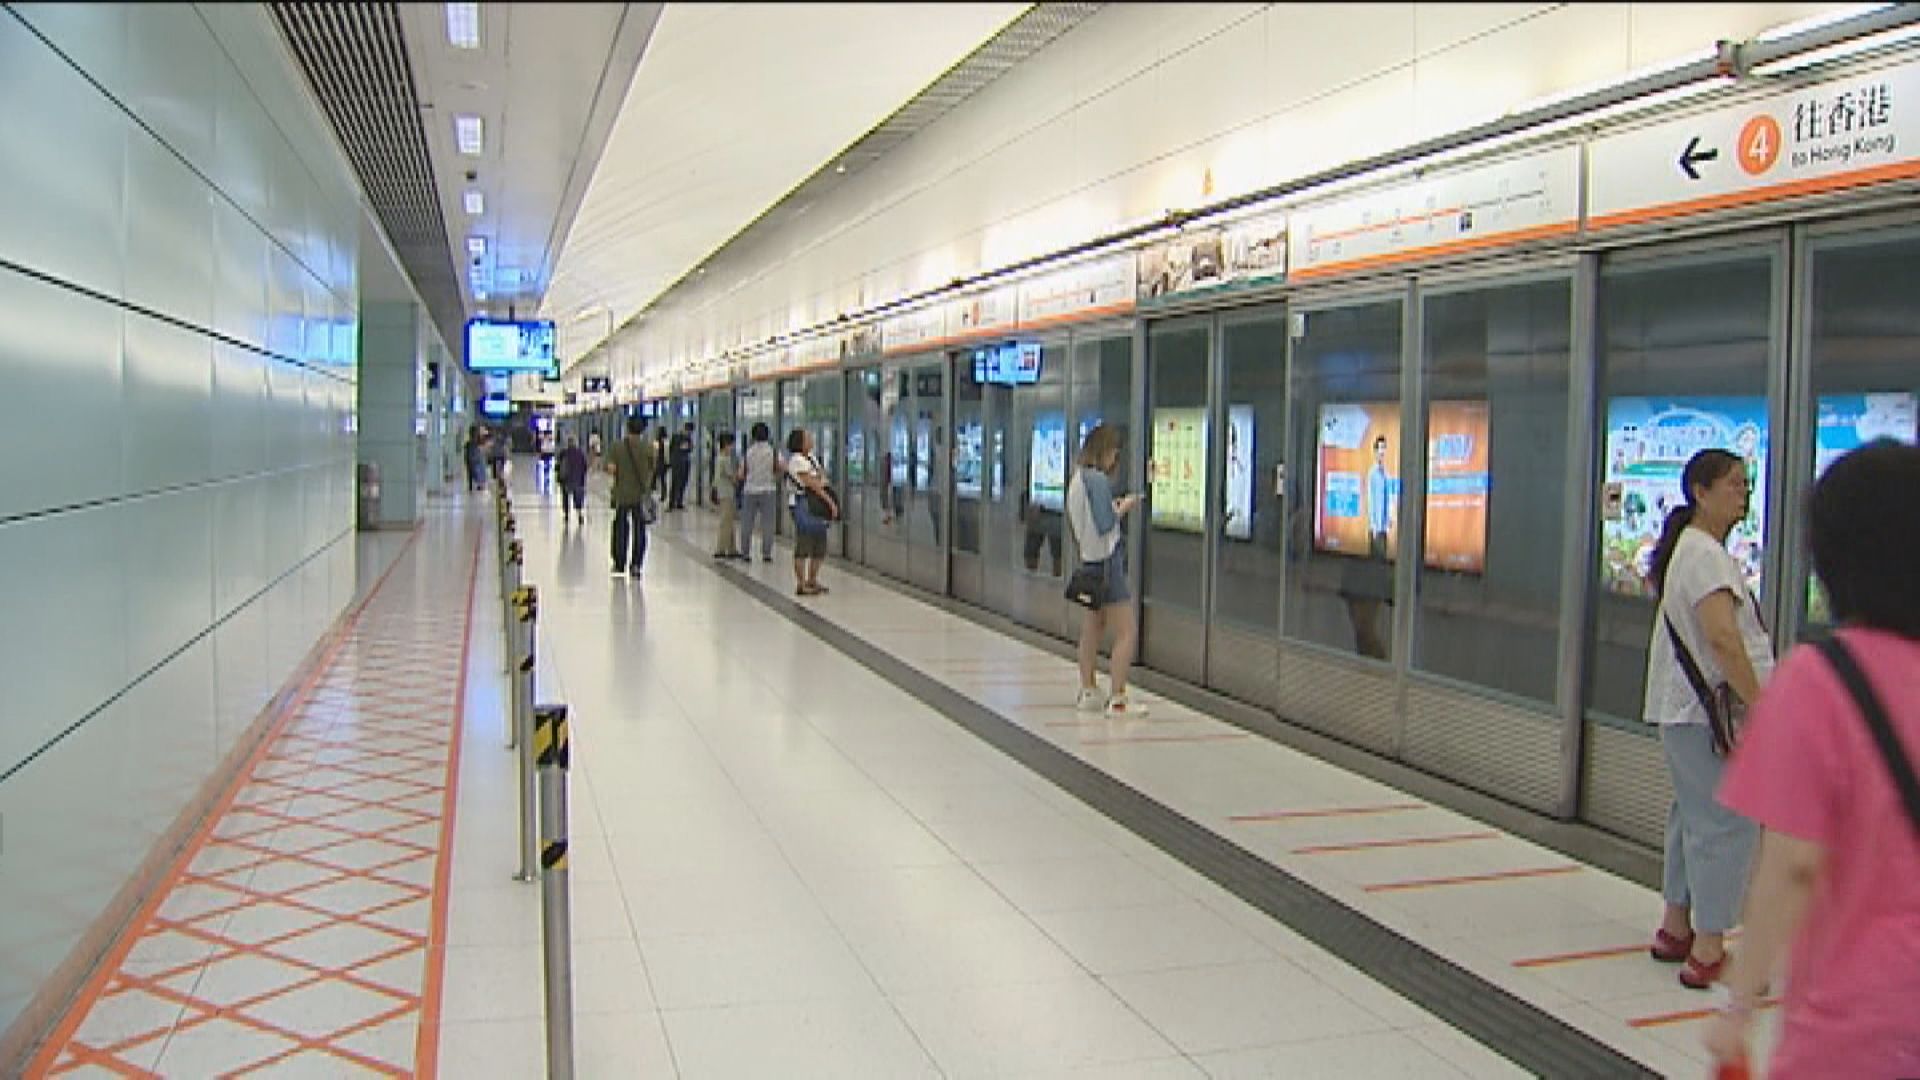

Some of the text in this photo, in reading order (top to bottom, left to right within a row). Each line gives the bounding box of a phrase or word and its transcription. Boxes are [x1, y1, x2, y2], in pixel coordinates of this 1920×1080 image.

[1793, 84, 1891, 142] 往香港
[1749, 126, 1768, 162] 4
[1792, 133, 1894, 168] to Hong Kong
